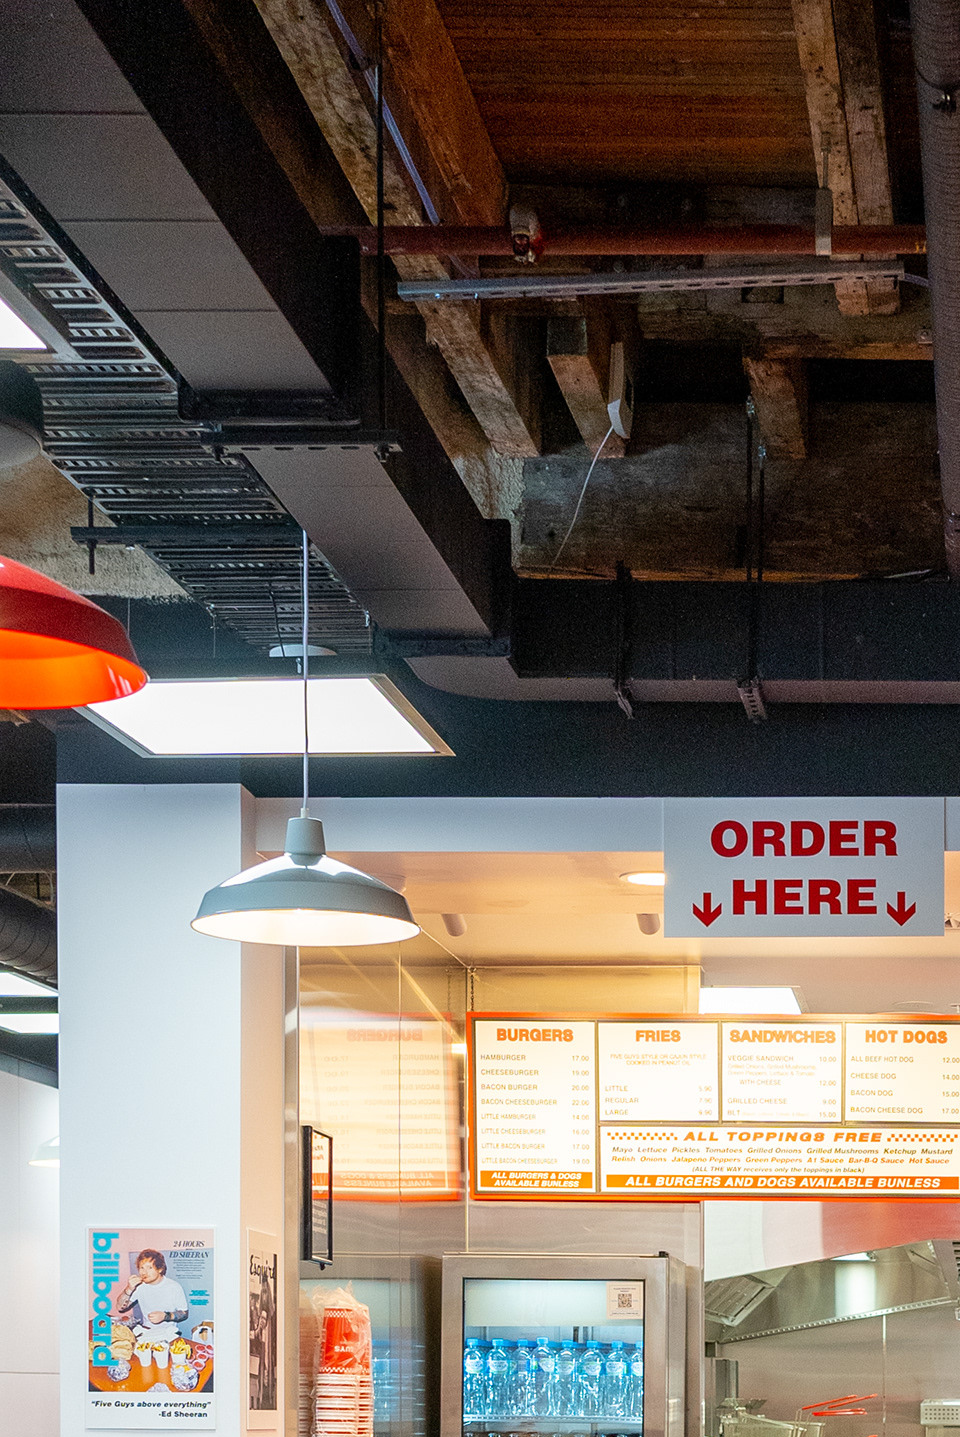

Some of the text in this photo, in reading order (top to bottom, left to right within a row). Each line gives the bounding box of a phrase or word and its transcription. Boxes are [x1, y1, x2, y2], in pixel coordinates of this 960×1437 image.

[710, 820, 898, 858] ORDER
[732, 879, 877, 915] HERE
[496, 1028, 574, 1042] BURGERS
[635, 1030, 681, 1043] FRIES
[729, 1029, 836, 1044] SANDWICHES
[865, 1030, 948, 1044] HOT DOGS
[683, 1131, 883, 1143] ALL TOPPINGS FREE
[883, 1148, 917, 1156] Ketchup
[770, 1157, 803, 1165] Peppers
[625, 1177, 941, 1188] ALL BURGERS AND DOGS AVAILABLE BUNLESS
[92, 1232, 119, 1368] billboard
[114, 1401, 135, 1409] Guys
